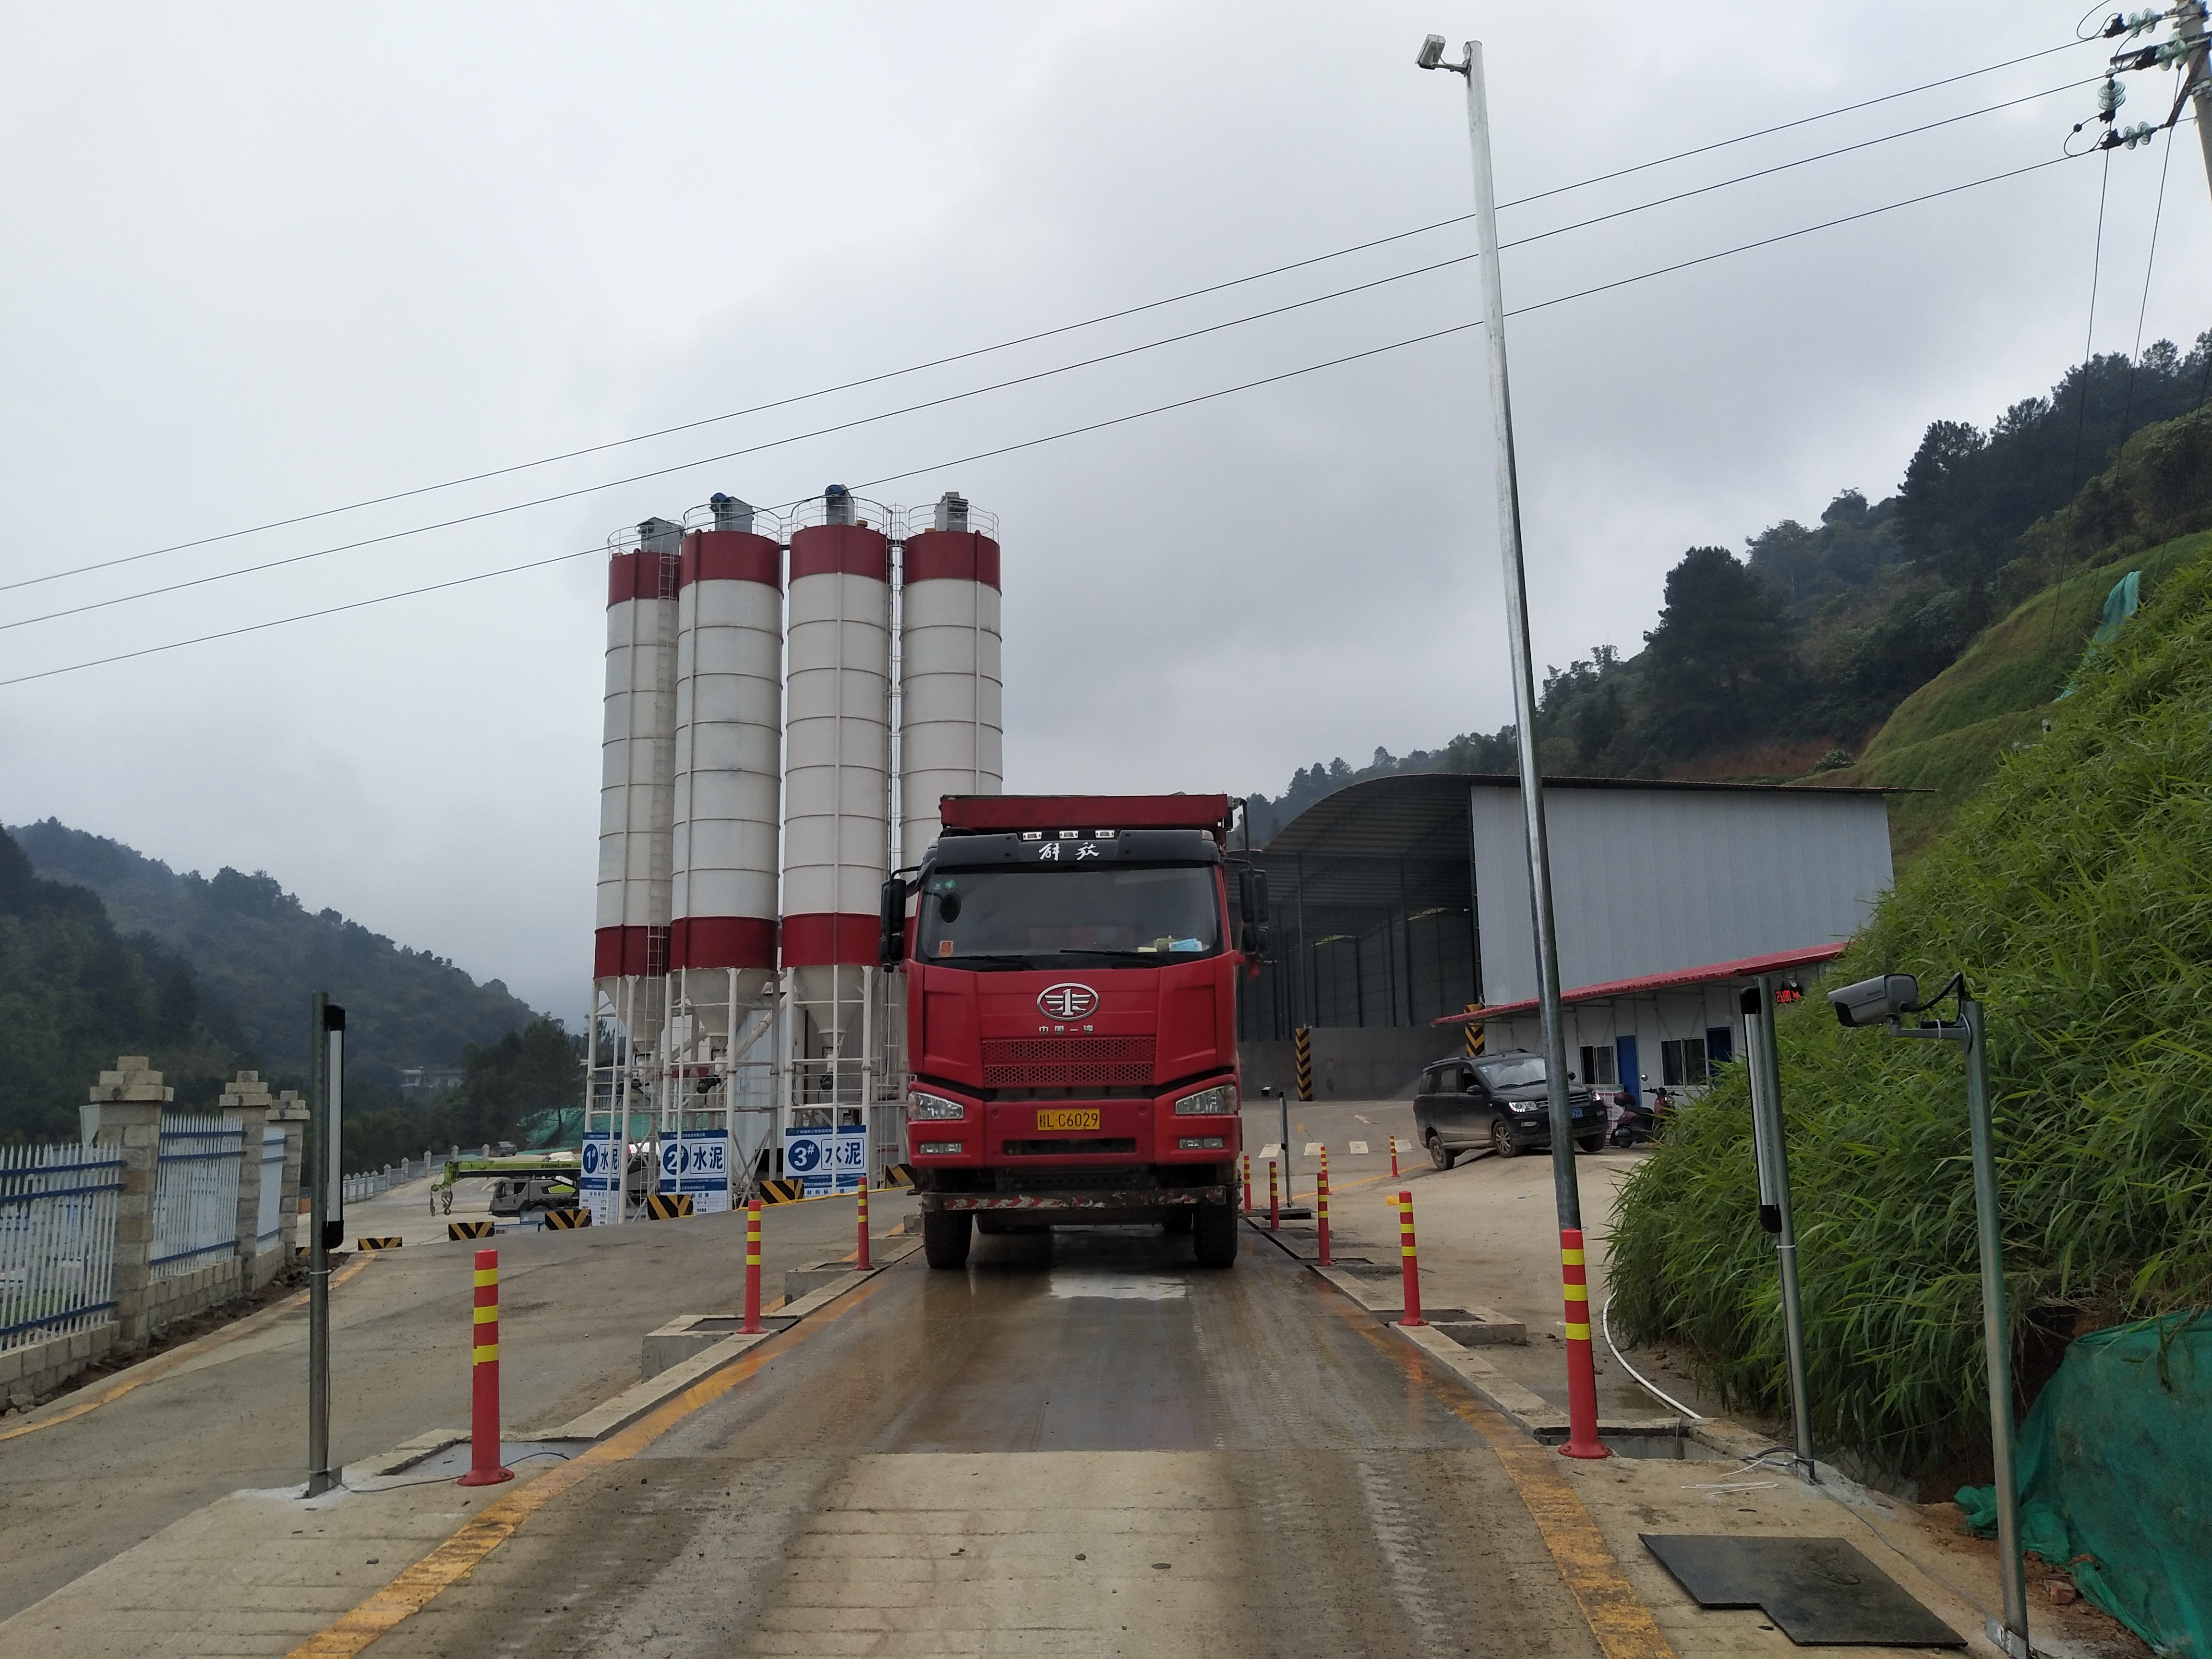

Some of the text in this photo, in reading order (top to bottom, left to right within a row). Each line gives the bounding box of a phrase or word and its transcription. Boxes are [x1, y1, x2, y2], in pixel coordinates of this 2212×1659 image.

[1038, 842, 1100, 861] 解放
[1039, 1024, 1094, 1034] 中国一汽
[586, 1148, 596, 1169] 1#
[693, 1146, 723, 1171] 水泥
[794, 1142, 862, 1167] 3# 水泥
